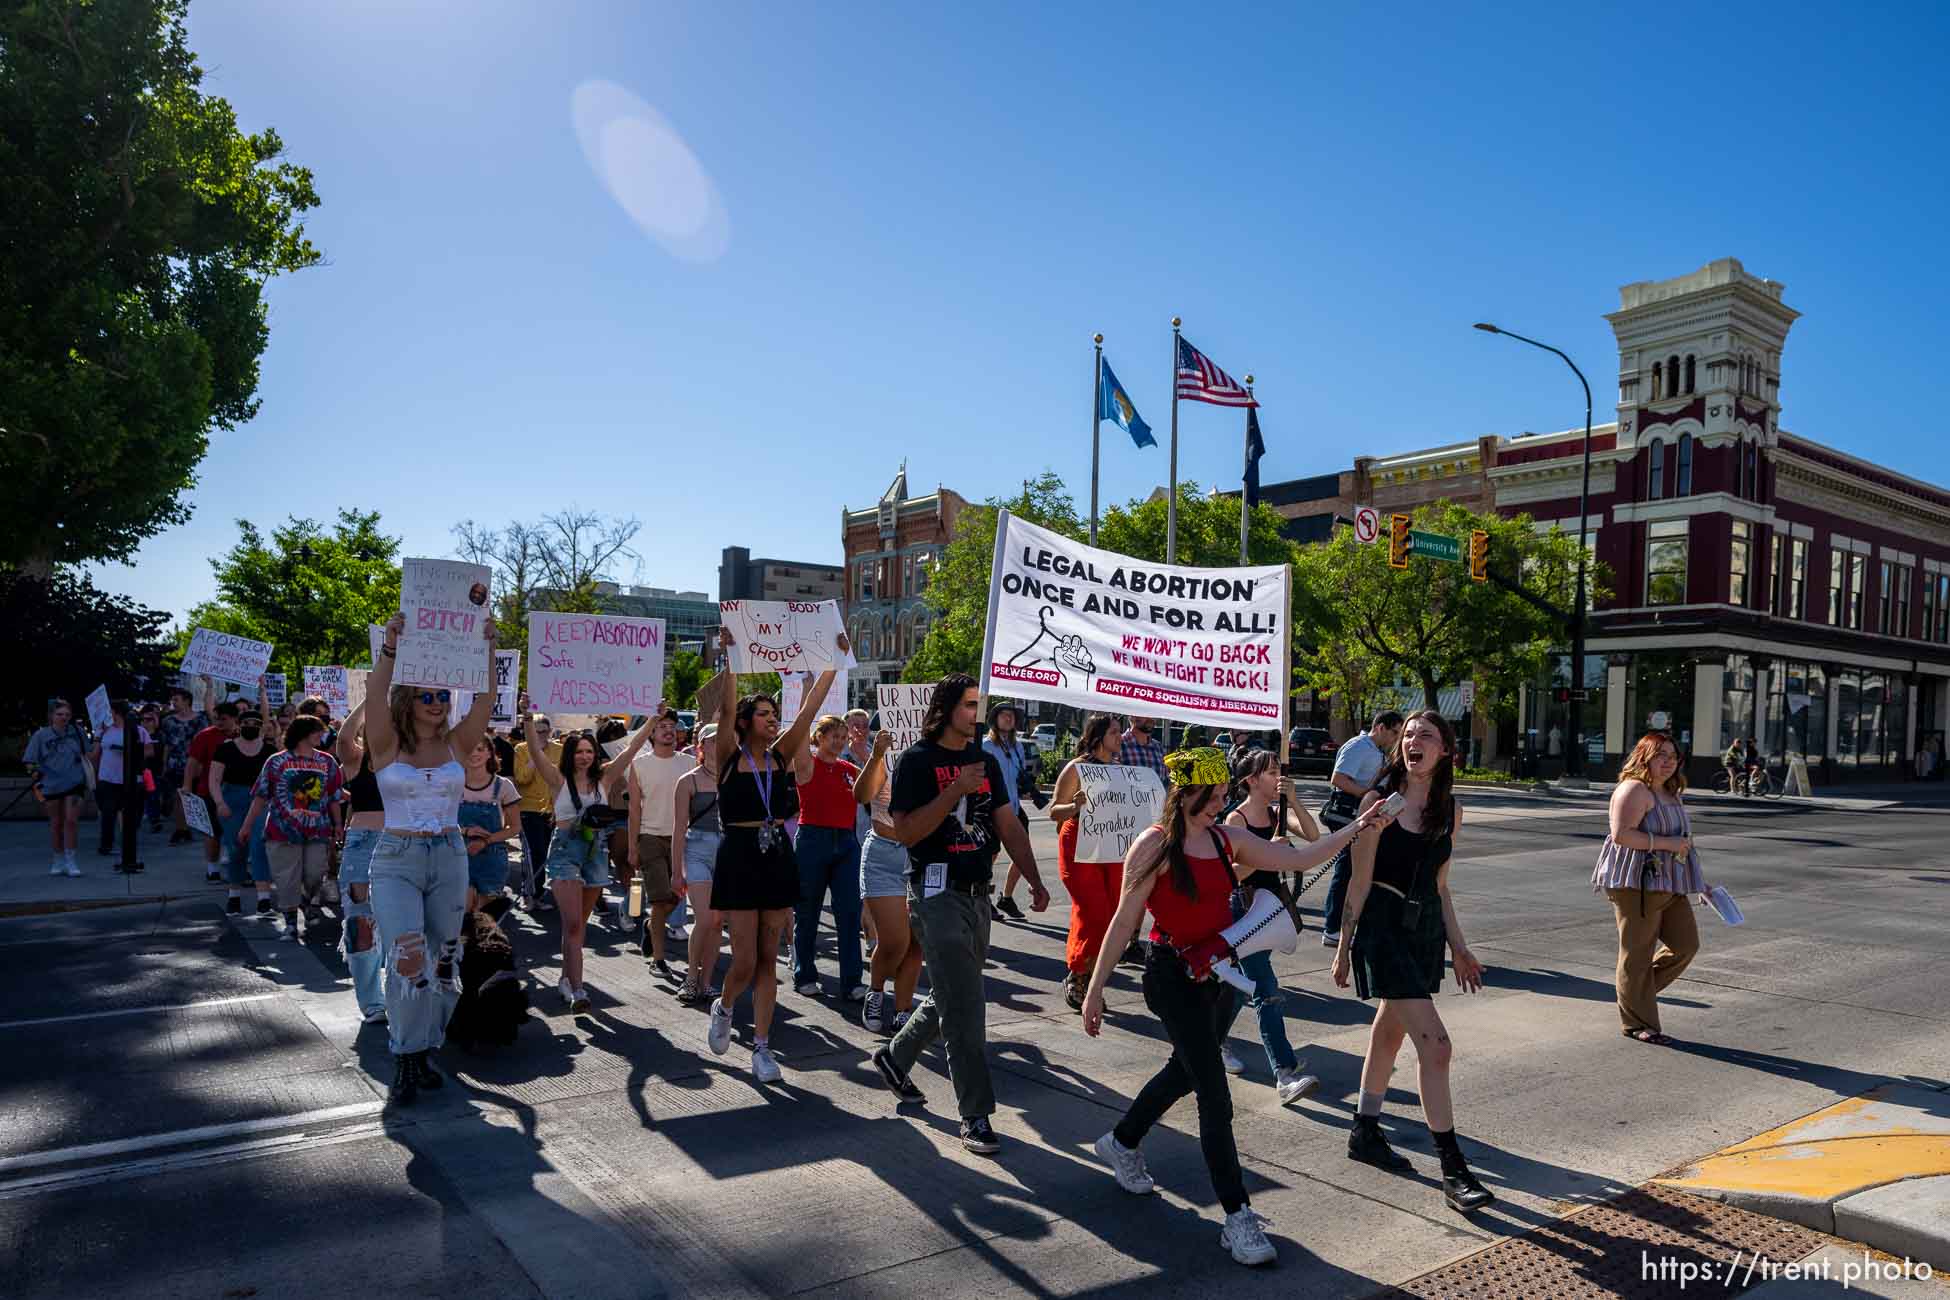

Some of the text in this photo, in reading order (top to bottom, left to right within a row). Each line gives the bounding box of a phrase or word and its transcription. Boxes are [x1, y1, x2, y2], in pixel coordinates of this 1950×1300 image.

[1415, 537, 1448, 554] University
[1023, 546, 1255, 602] LEGAL ABORTION
[720, 600, 740, 613] MY
[788, 602, 821, 614] BODY
[1002, 573, 1276, 634] ONCE AND FOR ALL!
[416, 607, 476, 633] BITCH
[759, 623, 783, 635] MY
[193, 629, 272, 655] ABORTION
[545, 620, 658, 648] KEEP ABORTION
[537, 645, 576, 668] Safe
[748, 641, 803, 663] CHOICE
[1122, 634, 1271, 665] WE WON'T GO BACK
[993, 665, 1058, 683] PSLWEB.ORG
[1112, 649, 1269, 692] WE WILL FIGHT BACK!
[549, 679, 656, 709] ACCESSIBLE
[880, 687, 900, 707] UR
[1099, 681, 1278, 716] PARTY FOR SOCIALISM & LIBERATION
[1080, 764, 1142, 782] ABORT THE
[1086, 784, 1158, 814] Supreme Court
